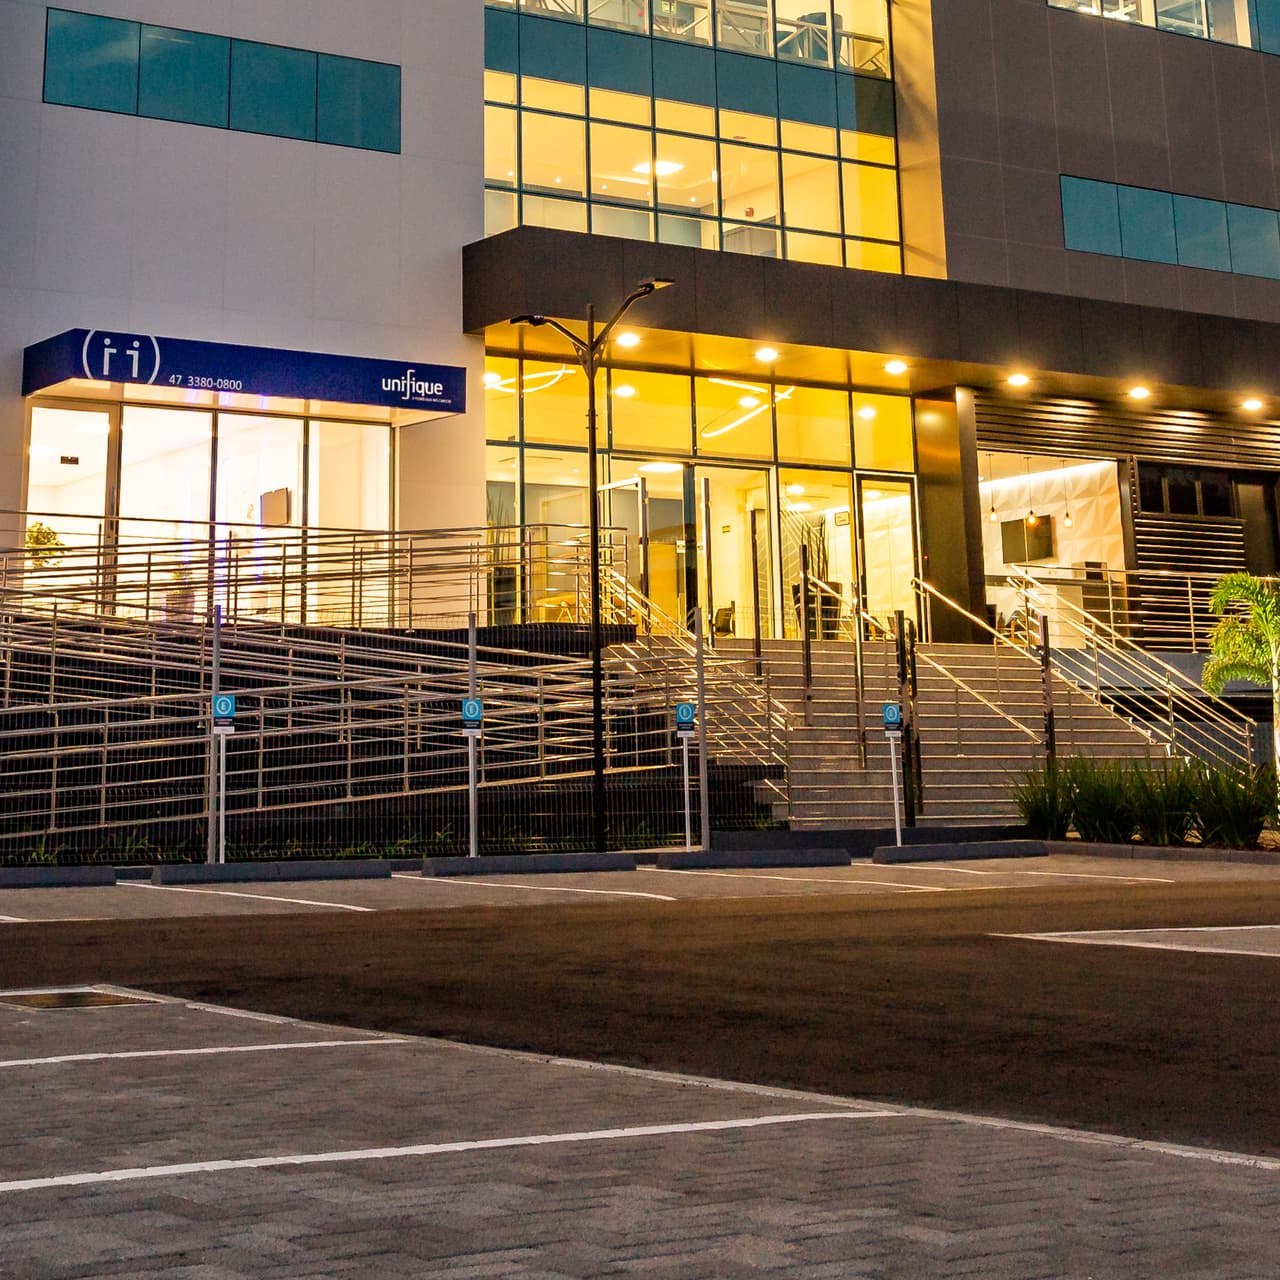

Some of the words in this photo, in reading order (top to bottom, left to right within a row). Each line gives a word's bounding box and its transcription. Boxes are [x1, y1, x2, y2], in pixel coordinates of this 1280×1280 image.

[168, 374, 182, 385] 47
[187, 375, 242, 391] 3380-0800
[382, 369, 443, 400] unifique
